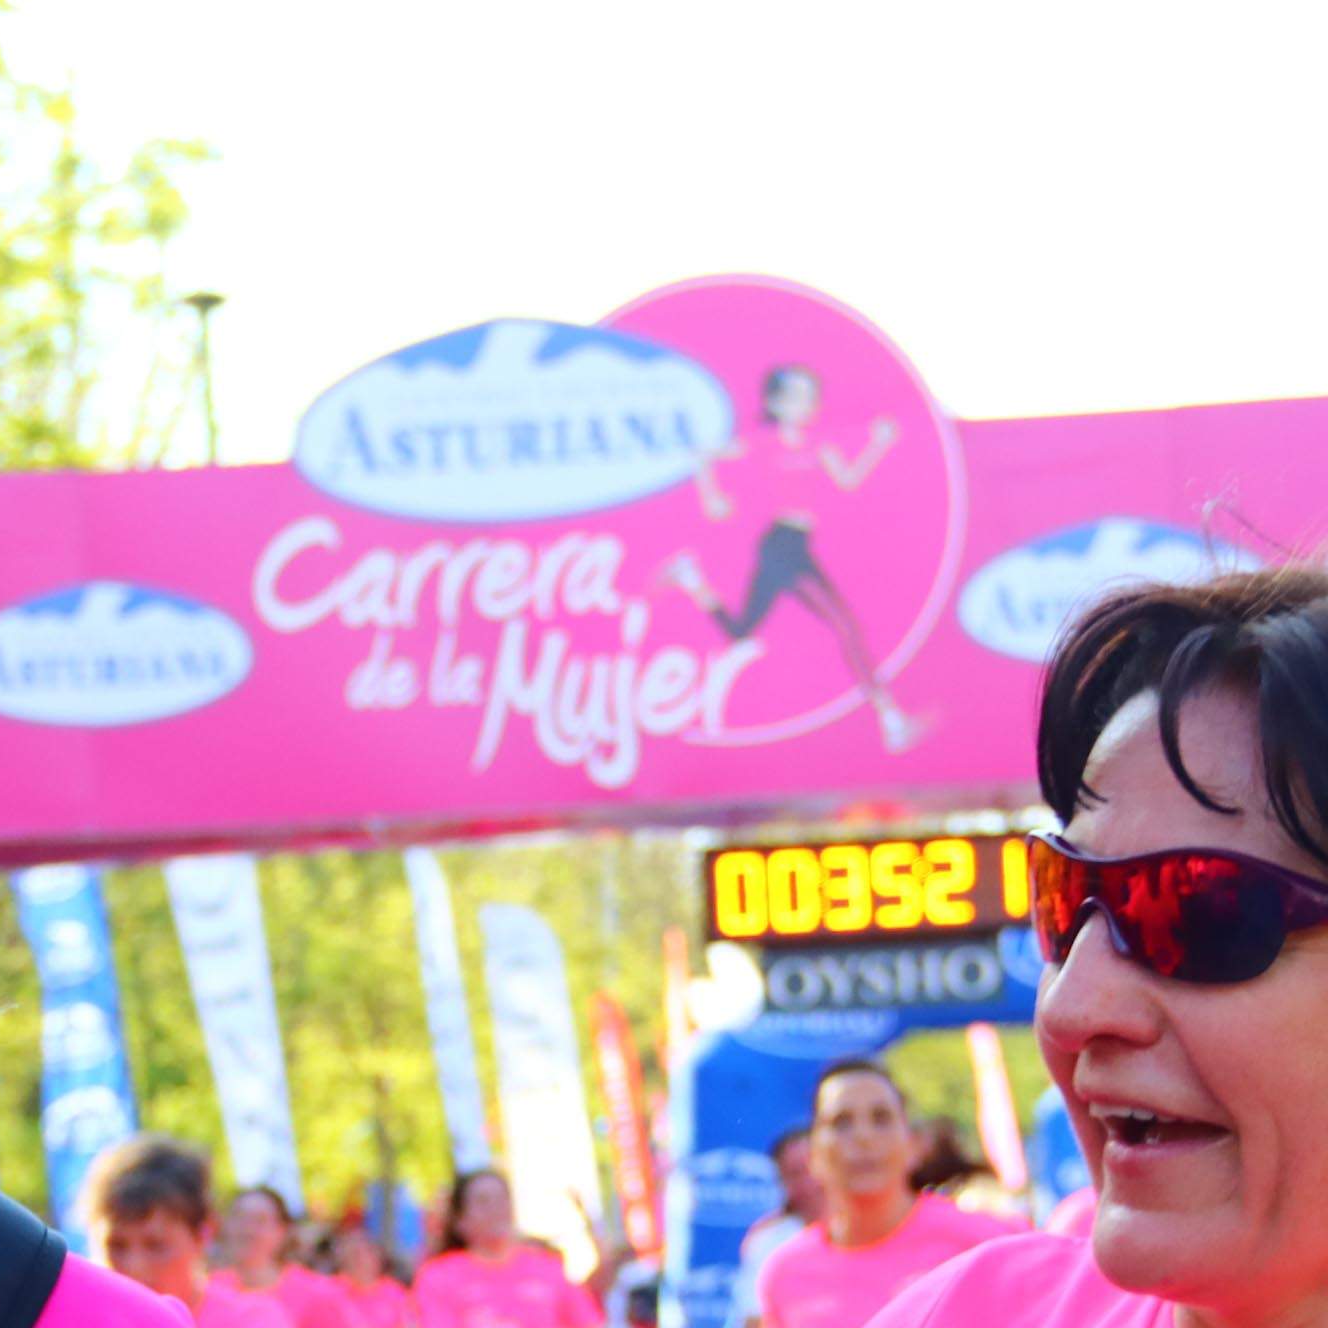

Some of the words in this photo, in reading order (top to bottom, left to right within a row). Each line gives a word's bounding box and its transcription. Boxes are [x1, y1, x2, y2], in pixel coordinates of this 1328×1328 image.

[329, 405, 700, 479] ASTURIANA
[252, 516, 624, 633] Carrera
[345, 633, 420, 710] de
[429, 626, 484, 708] la
[474, 604, 764, 788] Mujer
[768, 945, 1001, 1011] OYSHO
